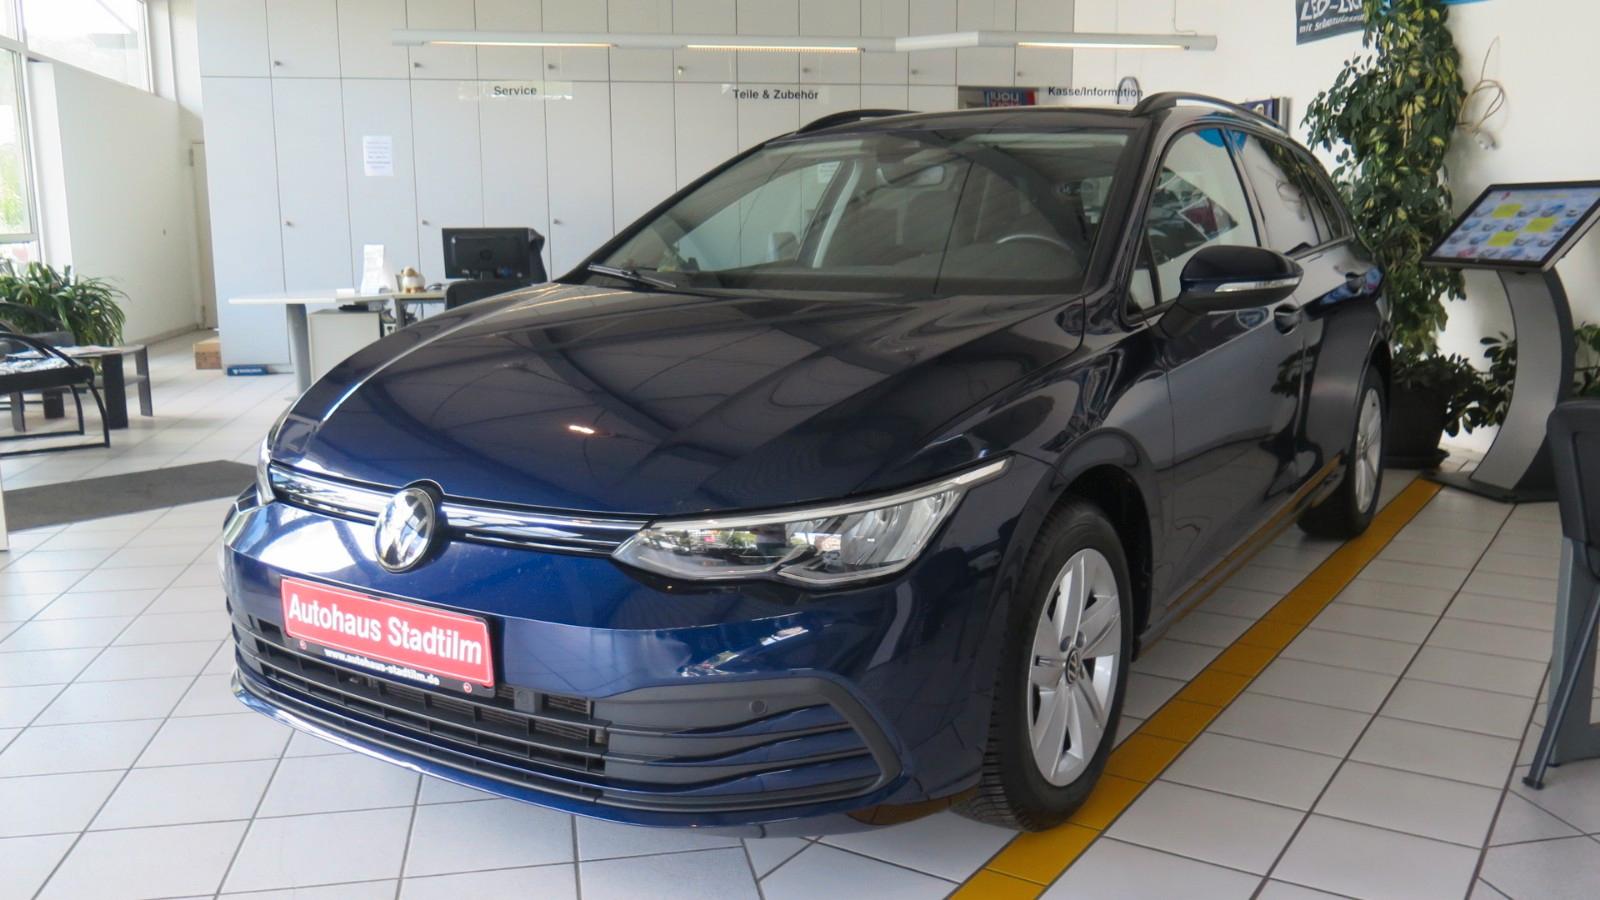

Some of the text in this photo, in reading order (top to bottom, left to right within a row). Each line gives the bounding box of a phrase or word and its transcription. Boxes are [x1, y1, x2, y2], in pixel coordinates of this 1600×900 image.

[493, 85, 537, 96] Service
[733, 89, 818, 100] Teile & Zubehör
[1048, 86, 1143, 97] Kasse/Information
[288, 593, 483, 665] Autohaus Stadtilm
[323, 648, 440, 686] www.autohaus-stadtilm.de
